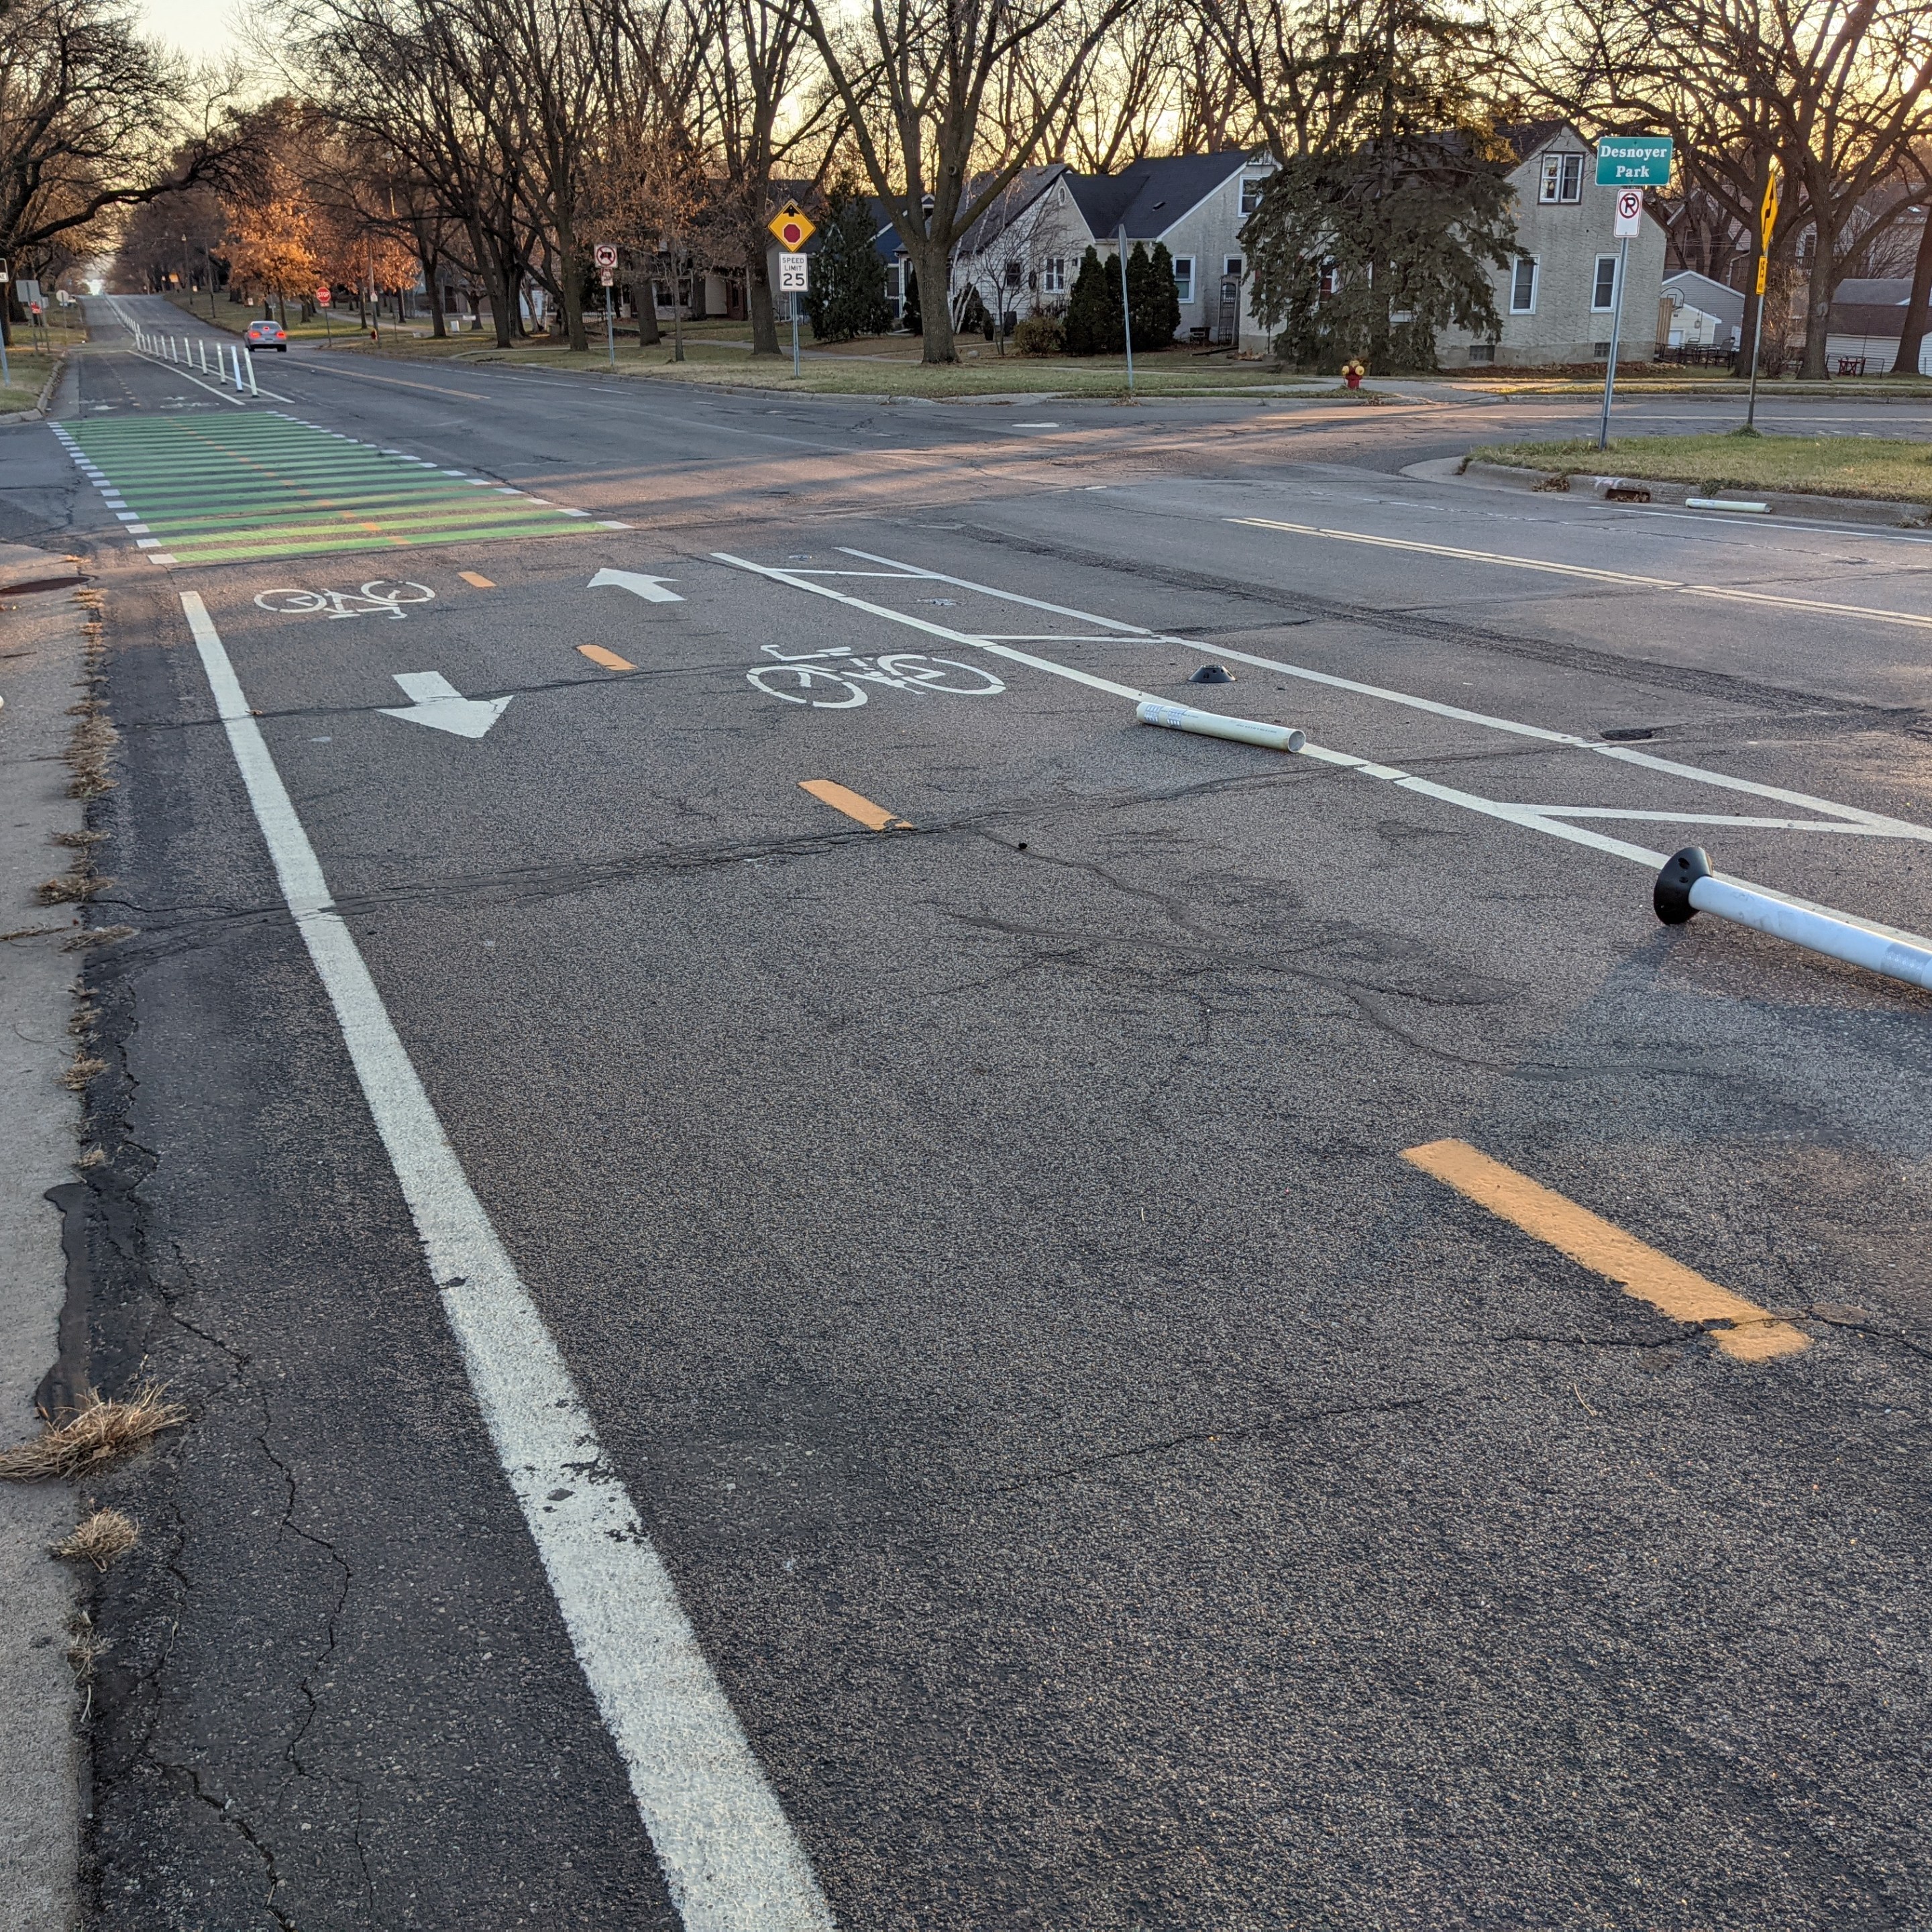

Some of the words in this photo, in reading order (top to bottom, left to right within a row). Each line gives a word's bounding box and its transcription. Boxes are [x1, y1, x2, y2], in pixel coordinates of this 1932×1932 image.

[1600, 145, 1667, 161] Desnoyer
[1615, 165, 1650, 178] Park
[783, 272, 805, 286] 25
